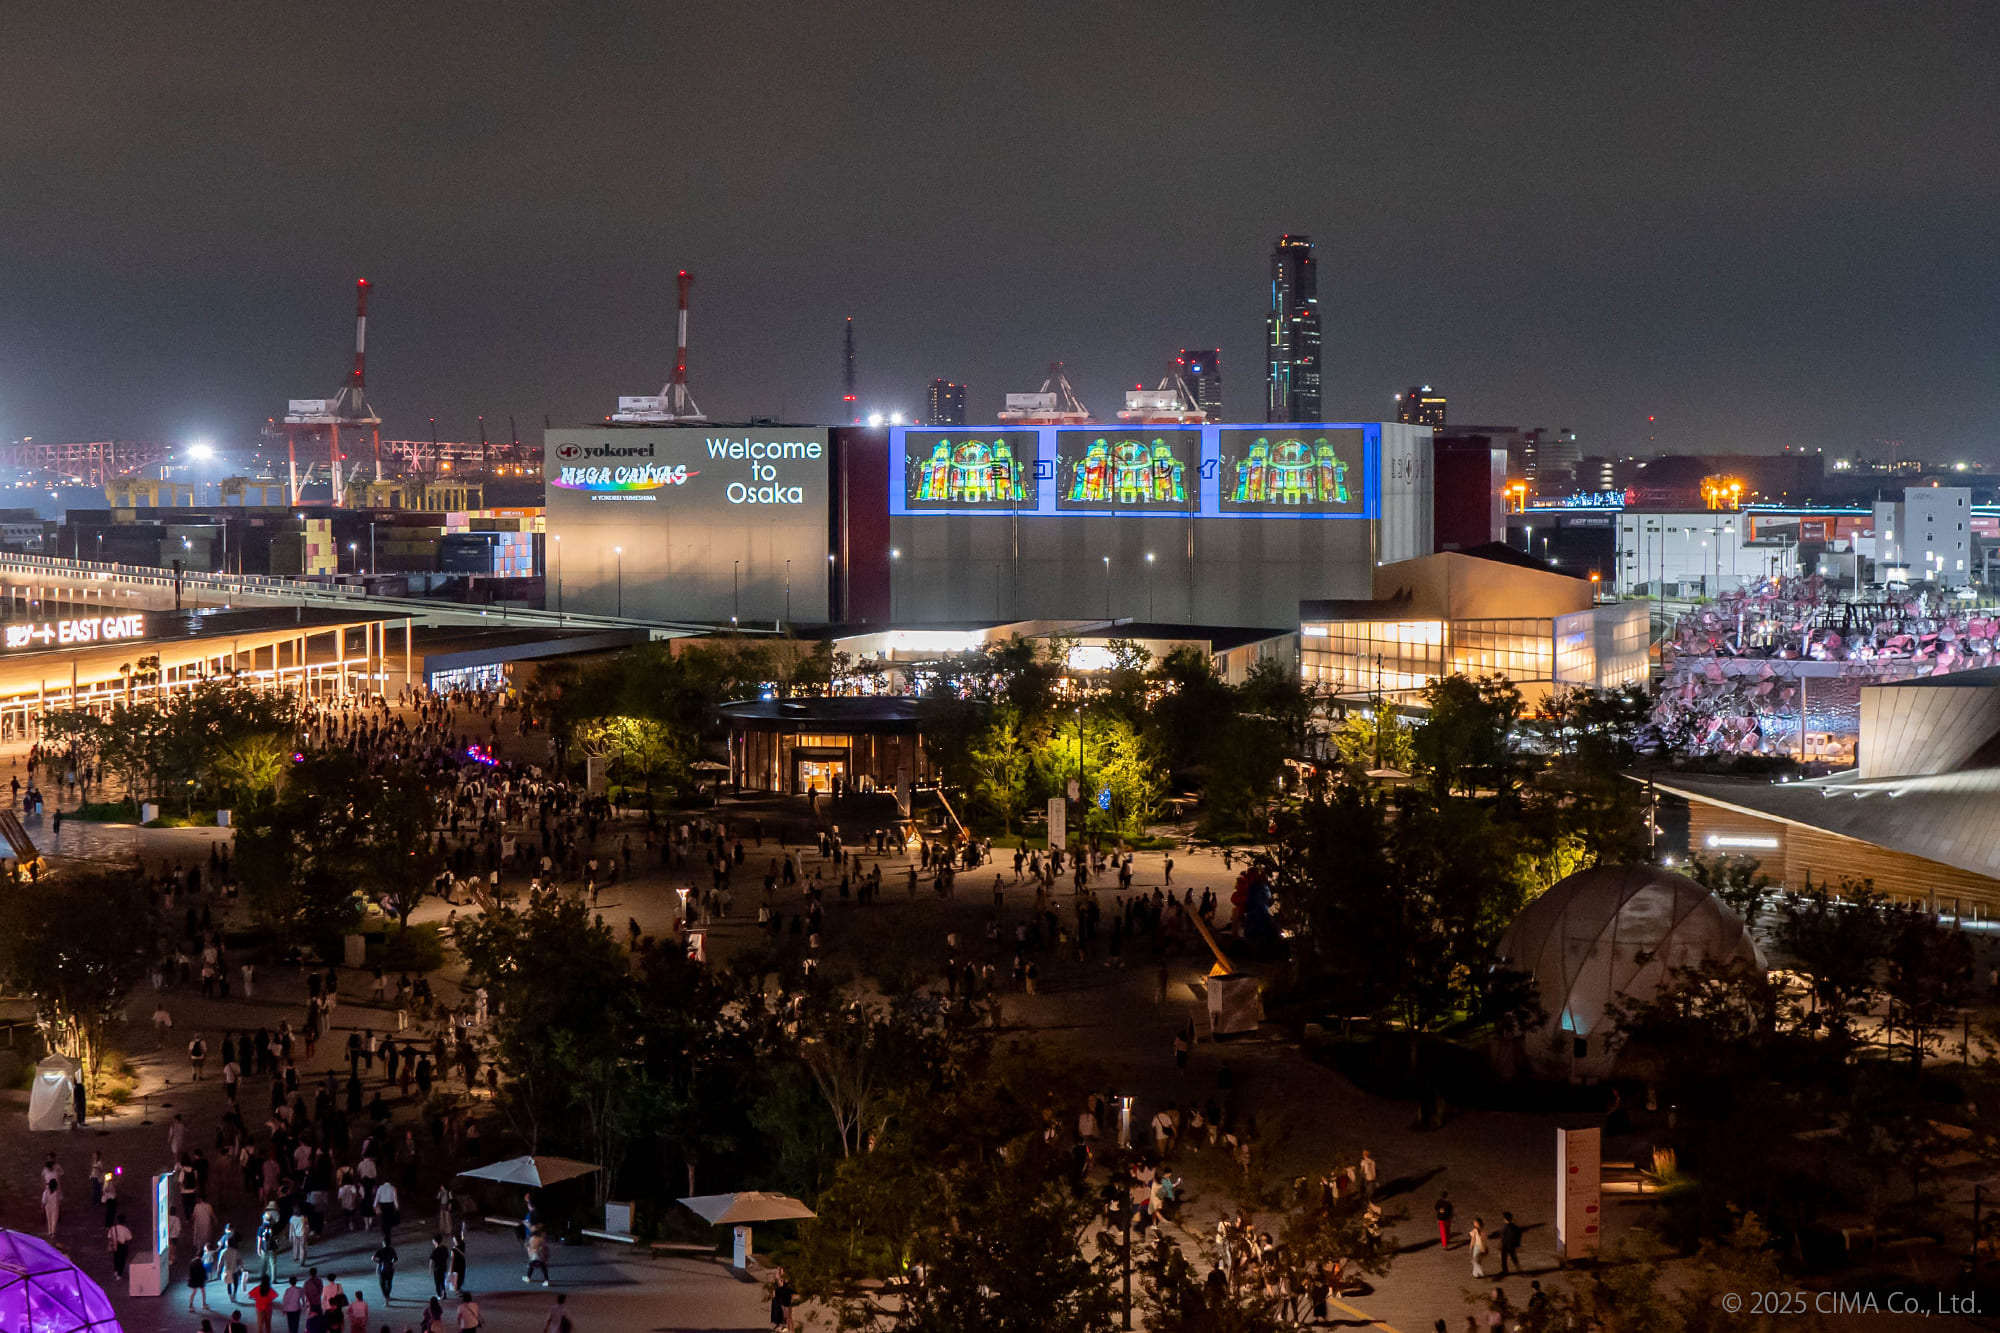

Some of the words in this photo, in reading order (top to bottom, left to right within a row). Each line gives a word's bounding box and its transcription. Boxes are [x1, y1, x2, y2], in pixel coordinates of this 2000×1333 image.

[583, 443, 655, 459] yokorei
[706, 437, 822, 460] Welcome
[560, 465, 613, 485] MEGA
[614, 462, 688, 486] CANVAS
[752, 460, 777, 481] to
[726, 482, 803, 504] Osaka
[59, 618, 101, 644] EAST
[102, 614, 144, 639] GATE
